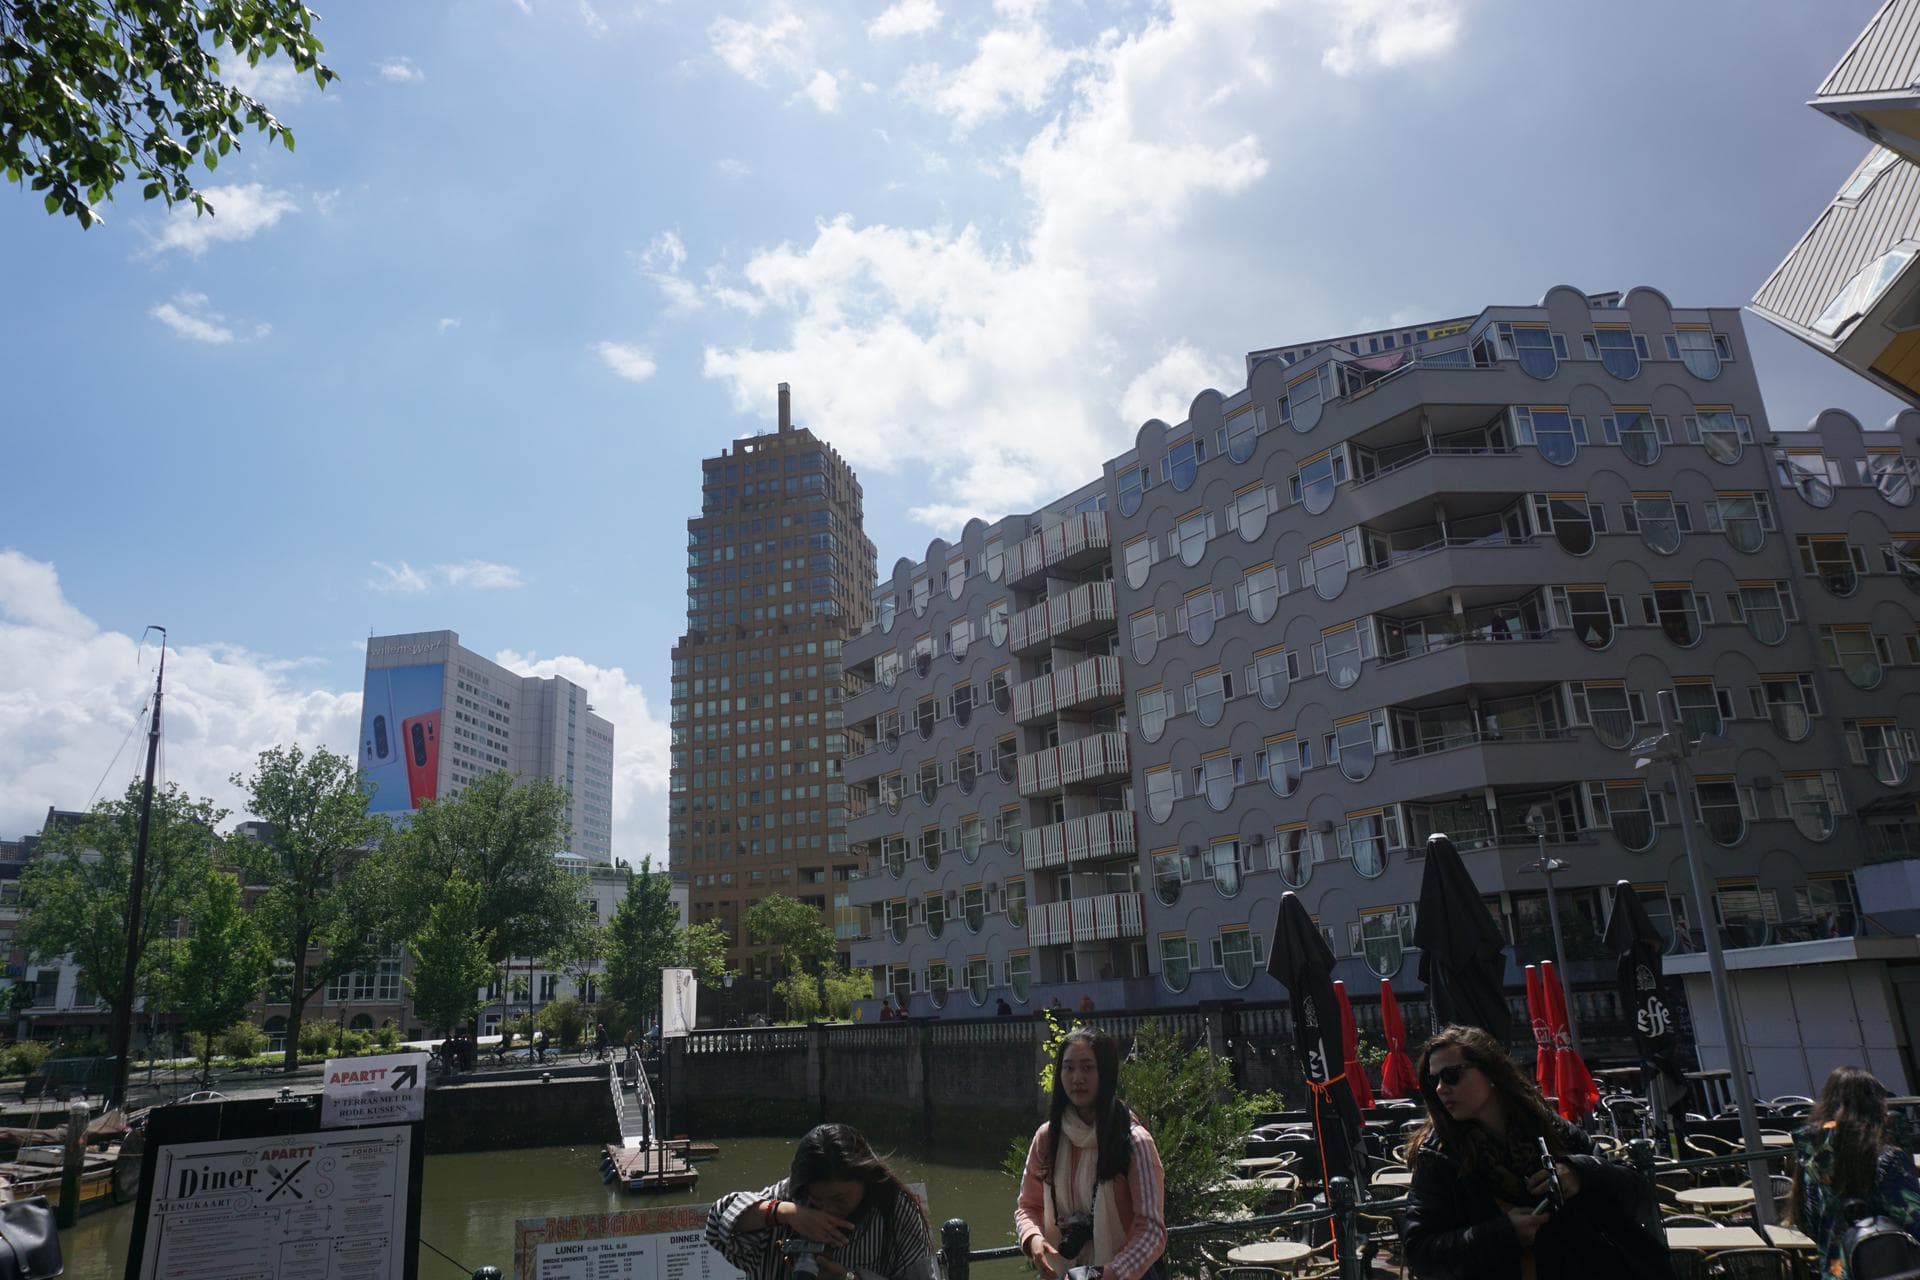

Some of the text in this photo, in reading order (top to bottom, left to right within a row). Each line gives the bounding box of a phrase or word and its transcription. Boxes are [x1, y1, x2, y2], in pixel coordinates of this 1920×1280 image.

[1637, 996, 1671, 1038] effe
[330, 1068, 388, 1084] APARTT
[343, 1098, 379, 1107] TERRAS
[380, 1095, 398, 1104] MET
[339, 1109, 365, 1118] RODE
[367, 1105, 408, 1115] KUSSENS
[260, 1146, 316, 1161] APARTT
[178, 1166, 258, 1199] Diner
[156, 1199, 232, 1213] MENUKAART
[656, 1208, 699, 1228] CLUB
[670, 1234, 700, 1244] DINNER
[555, 1245, 584, 1255] LUNCH
